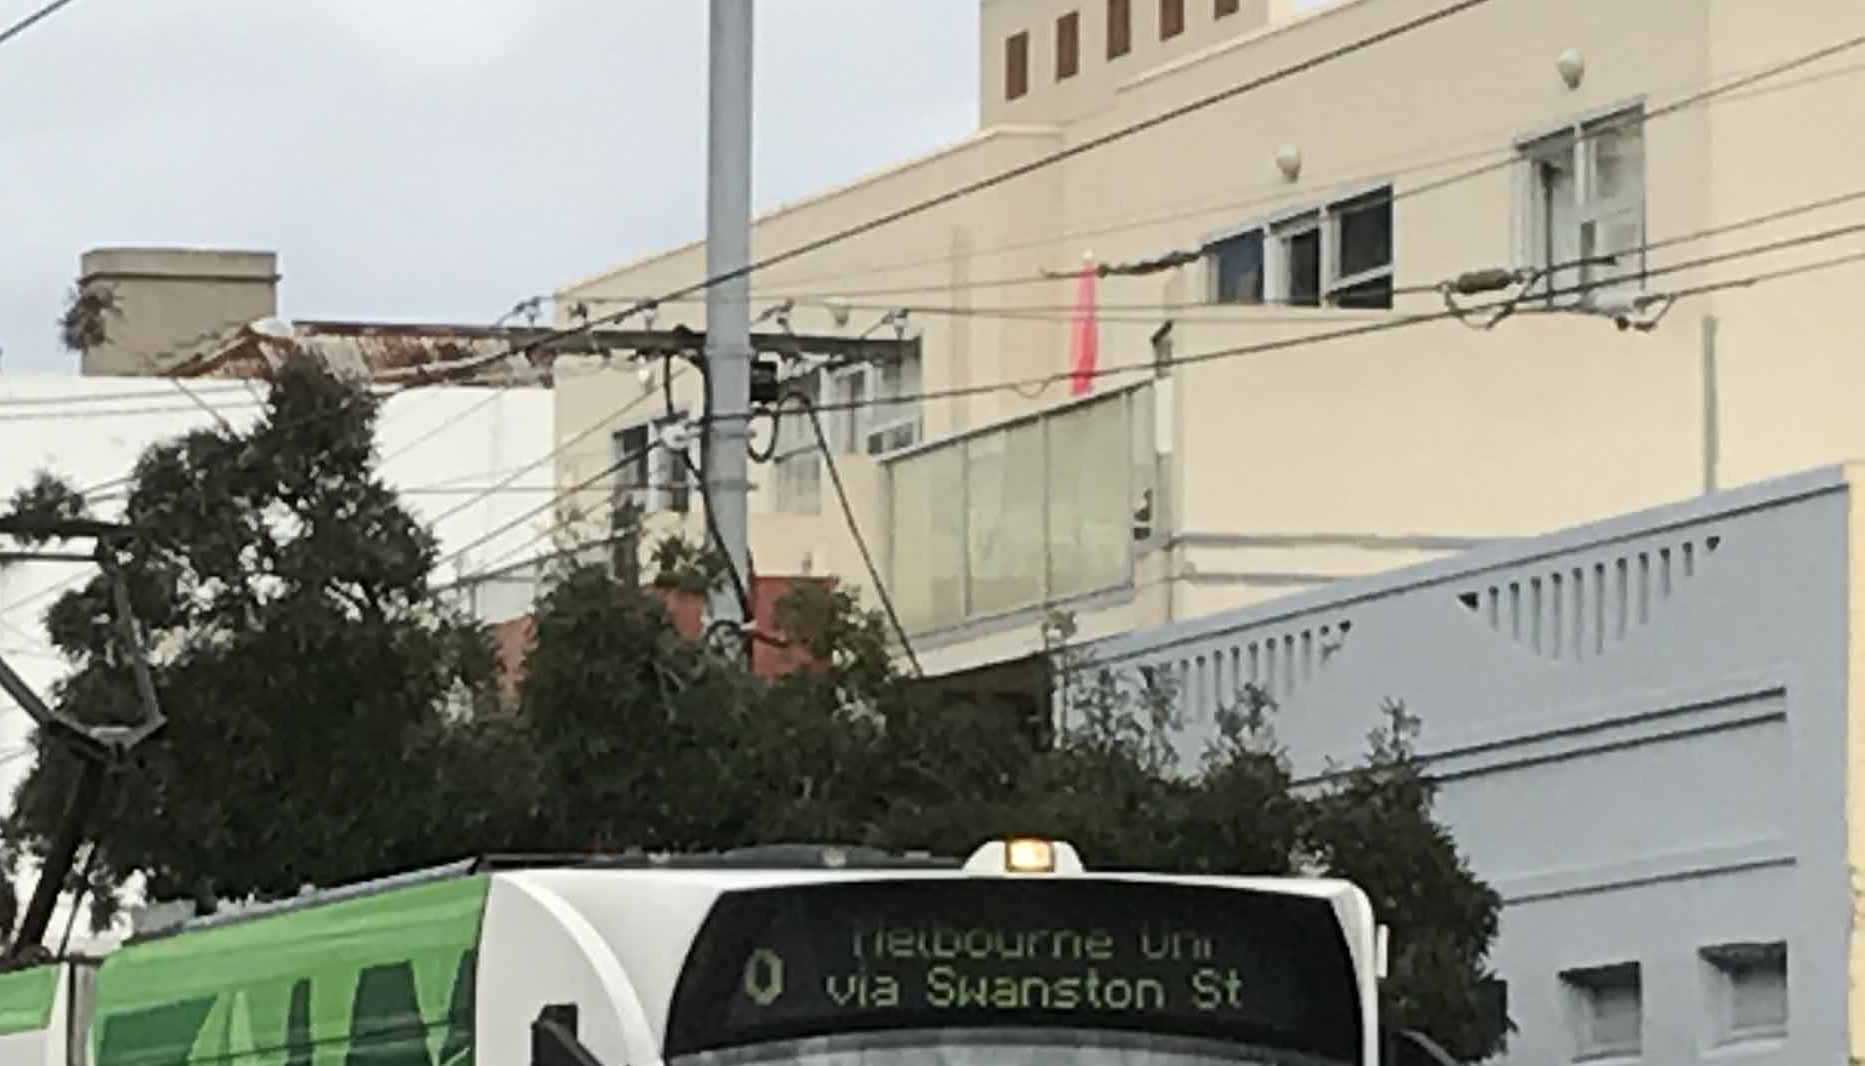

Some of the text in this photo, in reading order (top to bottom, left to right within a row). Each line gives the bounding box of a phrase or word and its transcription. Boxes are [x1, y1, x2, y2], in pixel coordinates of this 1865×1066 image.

[826, 965, 1243, 1010] via Swanston St
